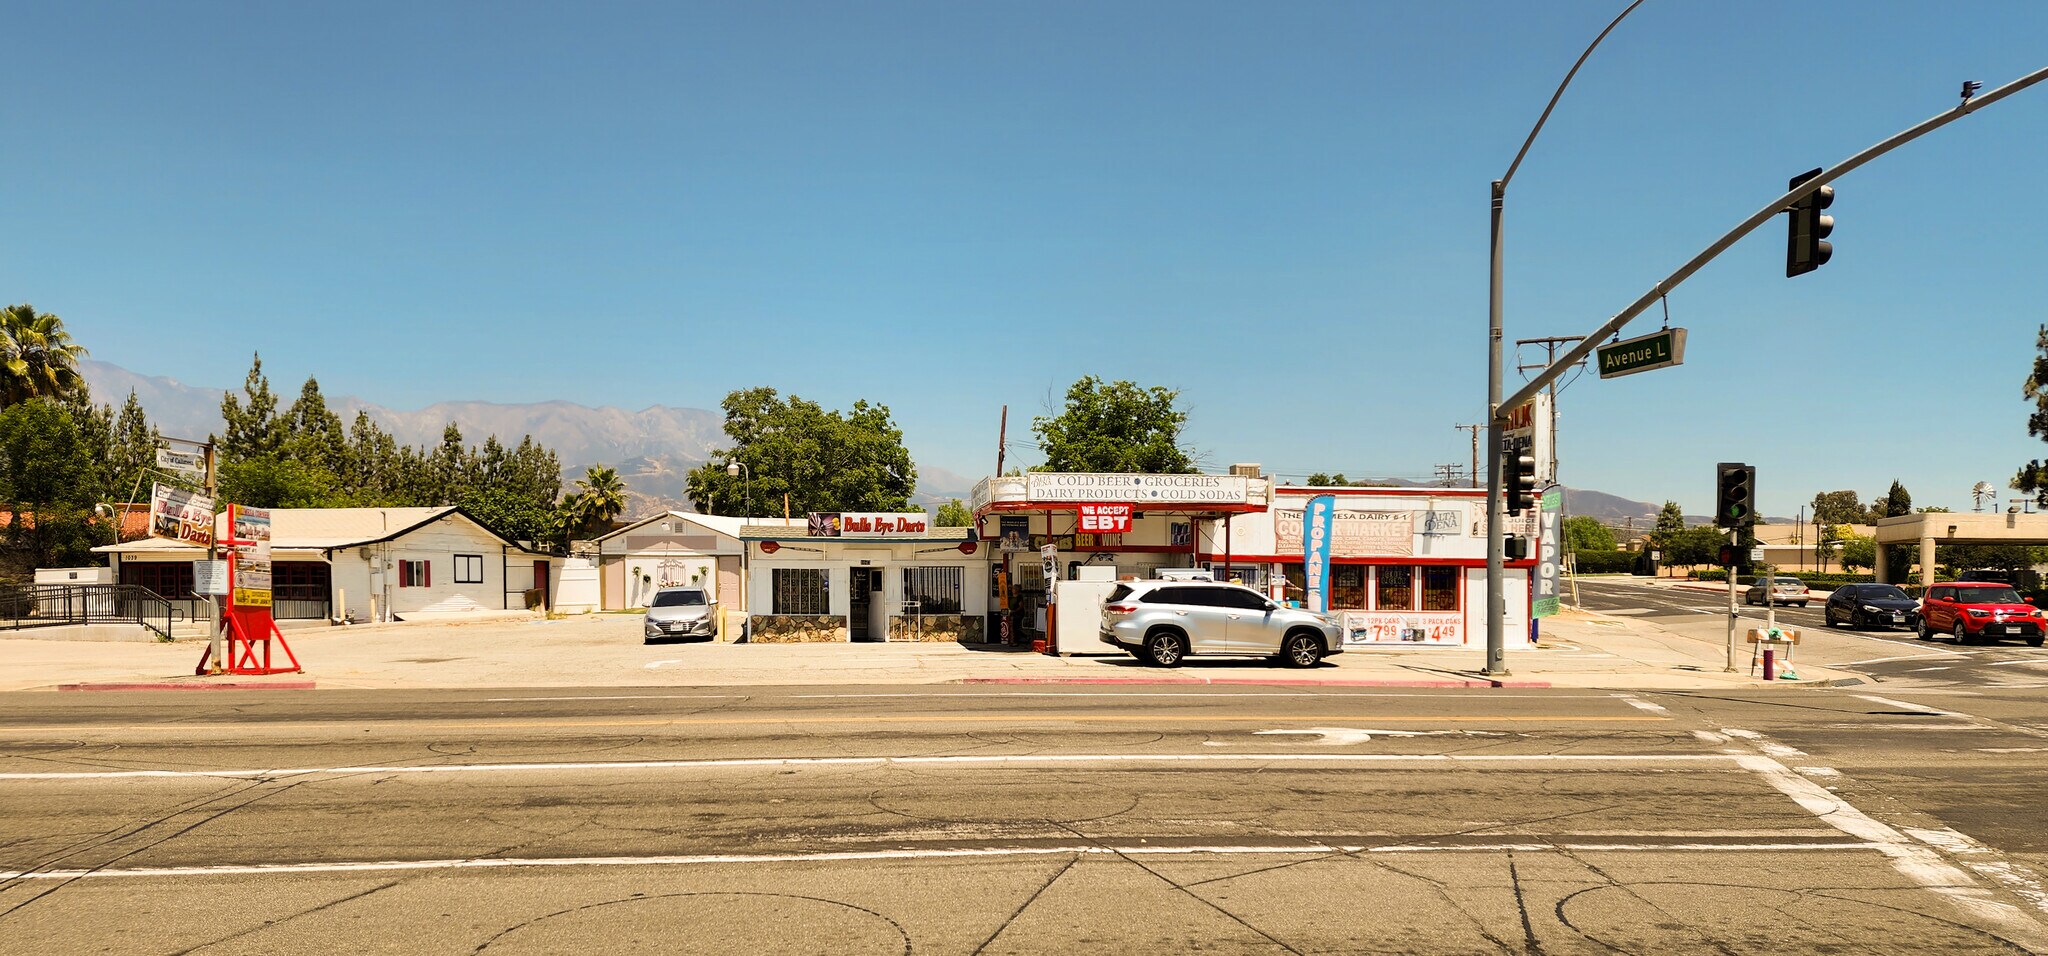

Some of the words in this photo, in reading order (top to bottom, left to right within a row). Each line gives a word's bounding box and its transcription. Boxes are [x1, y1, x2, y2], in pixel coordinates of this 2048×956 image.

[1606, 347, 1652, 368] Avenue
[1657, 342, 1666, 357] L
[1057, 476, 1096, 486] COLD
[1098, 476, 1131, 486] BEER
[1144, 477, 1220, 487] GROCERIES
[1036, 488, 1077, 498] DAIRY
[1078, 488, 1148, 499] PRODUCTS
[1160, 489, 1197, 499] COLD
[1199, 490, 1241, 500] SODAS
[157, 500, 189, 519] Bulls
[191, 508, 212, 526] Eye
[1081, 506, 1096, 514] WE
[1097, 506, 1129, 515] ACCEPT
[1430, 512, 1456, 521] ALTA
[843, 516, 872, 532] Bulls
[874, 516, 894, 535] Eye
[896, 516, 926, 533] Darts
[1082, 516, 1128, 529] EBT
[1350, 522, 1410, 536] MARKET
[1425, 520, 1458, 531] DENA
[1510, 524, 1537, 533] HERE
[180, 523, 211, 545] Darts
[1076, 533, 1094, 546] BEER
[1101, 533, 1122, 546] WINE
[1308, 503, 1326, 589] PROPANE
[1540, 512, 1556, 595] VAPOR
[1537, 599, 1557, 607] SOLD
[1537, 605, 1558, 614] HERE
